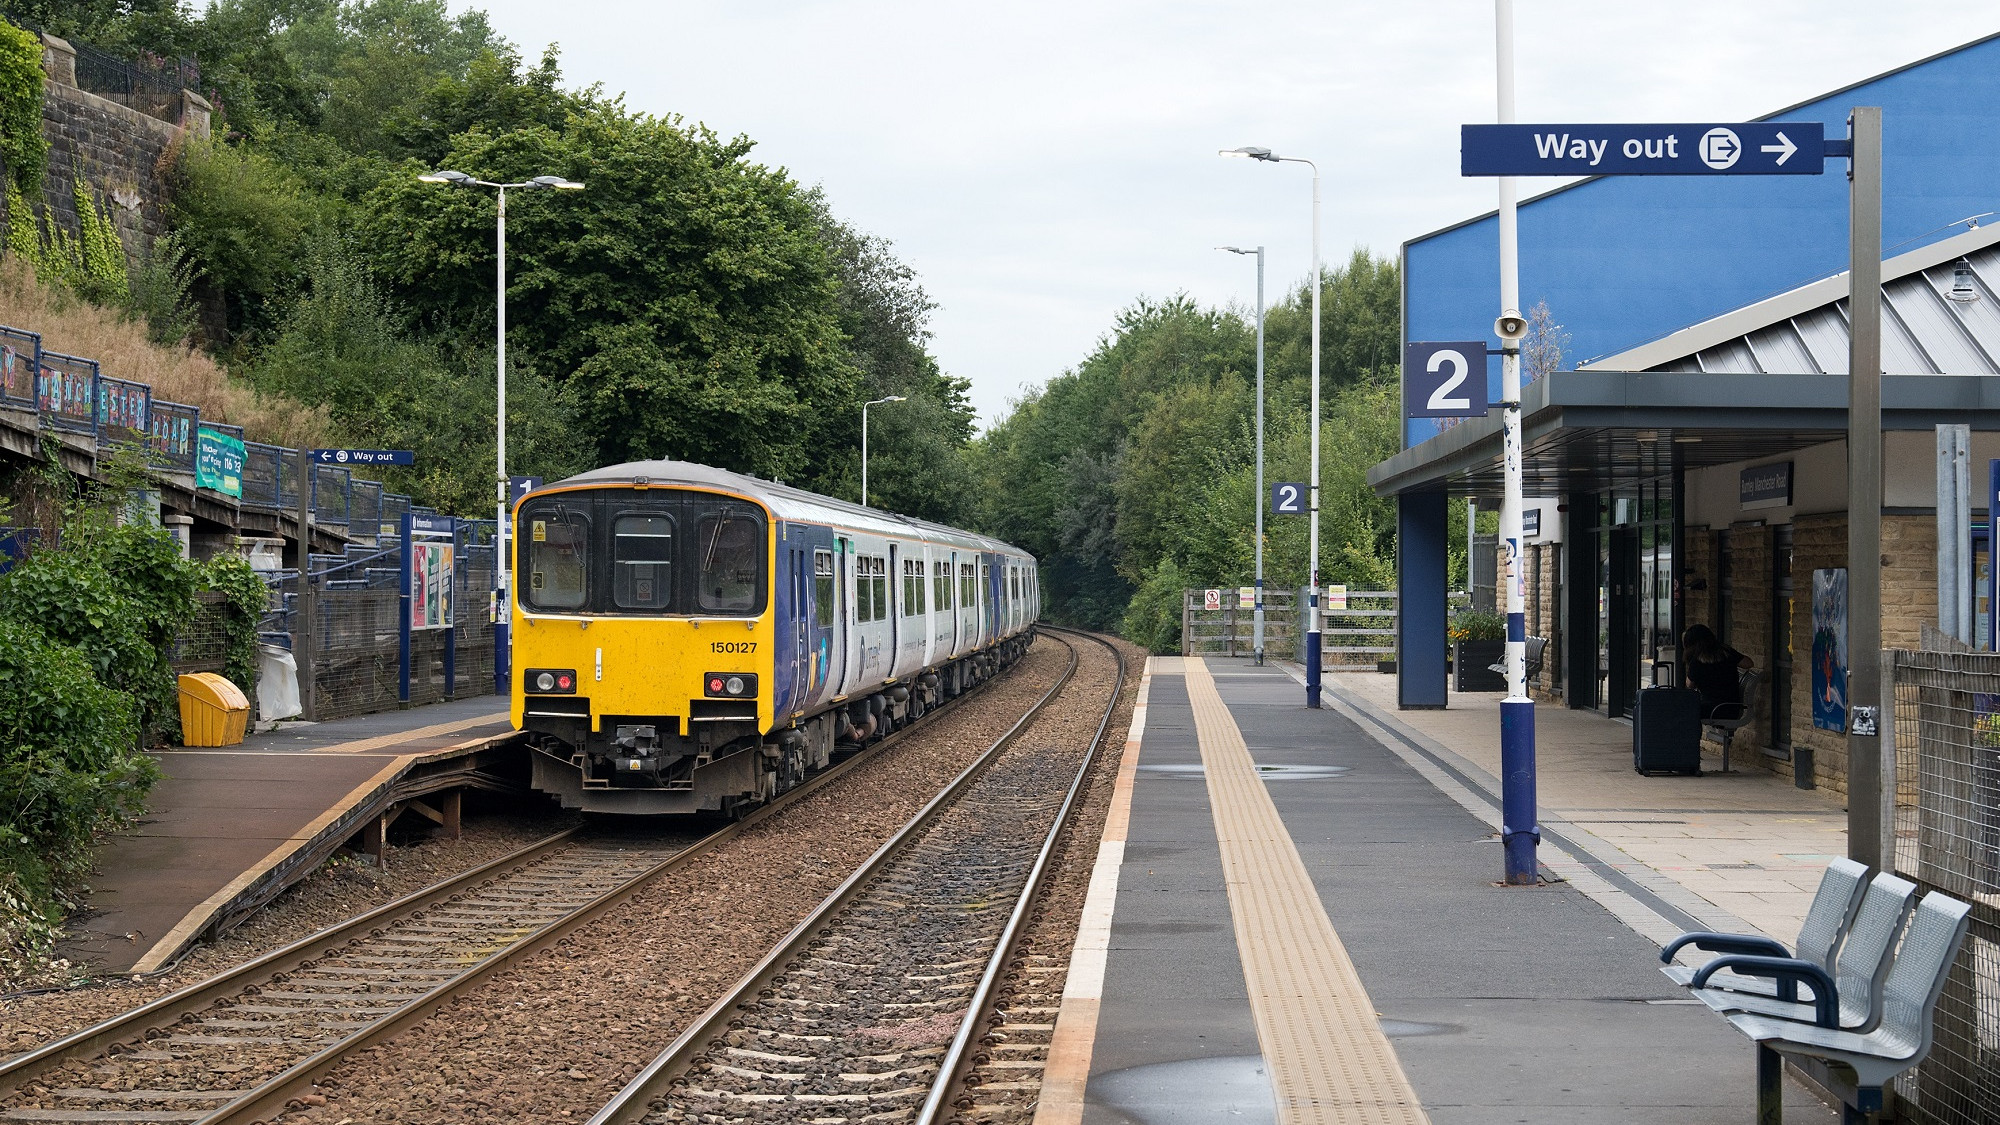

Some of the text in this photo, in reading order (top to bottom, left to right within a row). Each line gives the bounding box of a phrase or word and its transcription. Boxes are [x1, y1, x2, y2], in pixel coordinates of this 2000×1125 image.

[1533, 133, 1679, 166] Way out
[1425, 349, 1470, 410] 2
[353, 452, 394, 462] Way out
[519, 479, 532, 493] 1
[1279, 485, 1298, 511] 2
[710, 642, 758, 654] 150127
